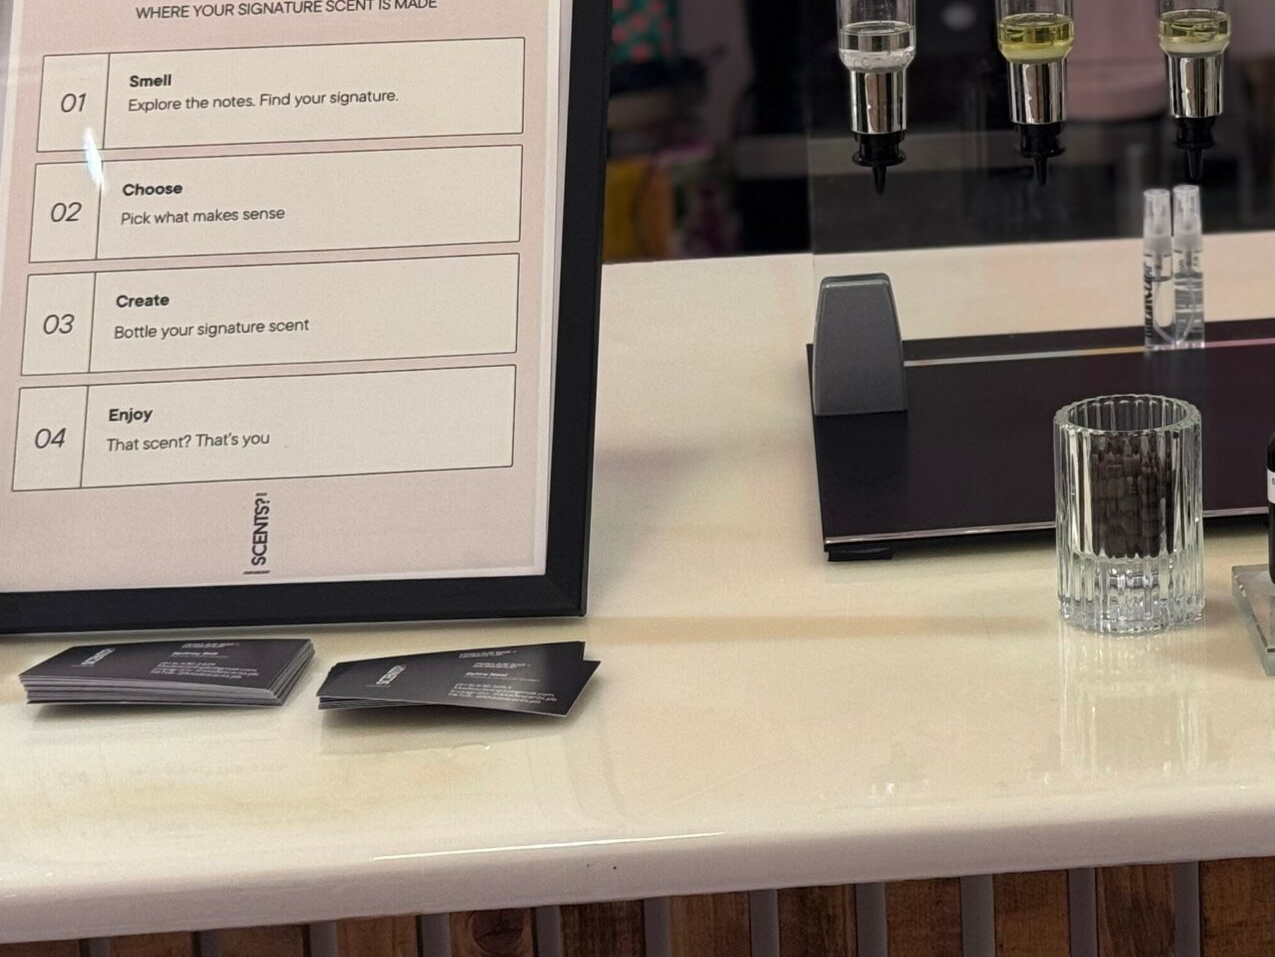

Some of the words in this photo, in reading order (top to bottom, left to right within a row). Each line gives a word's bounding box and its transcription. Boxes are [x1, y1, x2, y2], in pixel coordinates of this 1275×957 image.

[136, 5, 190, 19] WHERE
[193, 3, 235, 18] YOUR
[238, 0, 323, 16] SIGNATURE
[129, 74, 172, 88] Smell
[60, 92, 87, 114] 01
[128, 98, 182, 114] Explore
[185, 96, 209, 109] the
[212, 94, 256, 109] notes.
[260, 93, 291, 107] Find
[294, 93, 327, 108] your
[329, 90, 399, 107] signature.
[122, 183, 183, 197] Choose
[50, 201, 82, 223] 02
[121, 211, 151, 225] Pick
[153, 210, 189, 224] what
[192, 208, 239, 222] makes
[242, 207, 286, 220] sense
[116, 294, 170, 308] Create
[43, 313, 75, 335] 03
[114, 324, 158, 340] Bottle
[160, 325, 194, 340] your
[197, 321, 265, 338] signature
[268, 318, 310, 333] scent
[109, 408, 153, 424] Enjoy
[35, 427, 67, 449] 04
[107, 437, 140, 452] That
[143, 435, 192, 450] scent?
[195, 432, 239, 447] That's
[242, 433, 271, 448] you
